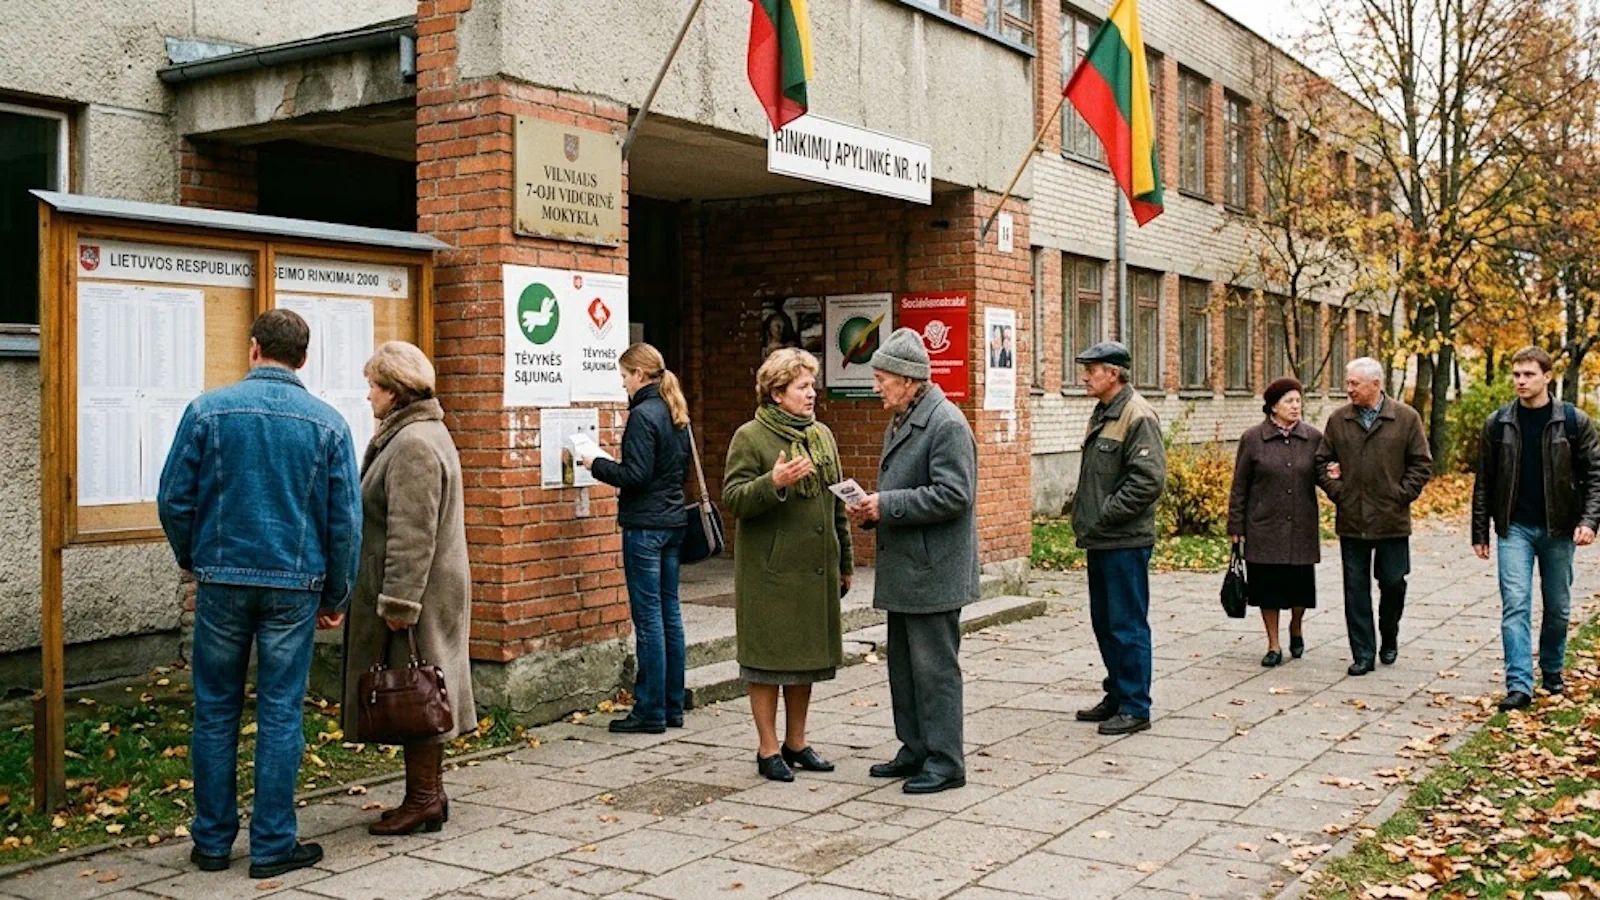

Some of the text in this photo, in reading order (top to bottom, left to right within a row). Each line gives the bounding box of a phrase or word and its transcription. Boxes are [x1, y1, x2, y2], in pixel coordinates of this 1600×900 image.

[775, 127, 927, 184] RINKIMŲ APYLINKĖ NR. 14
[543, 165, 598, 188] VILNIAUS
[526, 182, 614, 210] 7-OJI VIDURINĖ
[541, 205, 599, 227] MOKYKLA
[110, 252, 173, 271] LIETUVOS
[176, 258, 256, 278] RESPUBLIKOS
[307, 268, 355, 286] RINKIMAI
[356, 272, 380, 287] 2000
[514, 370, 563, 385] SĄJUNGA
